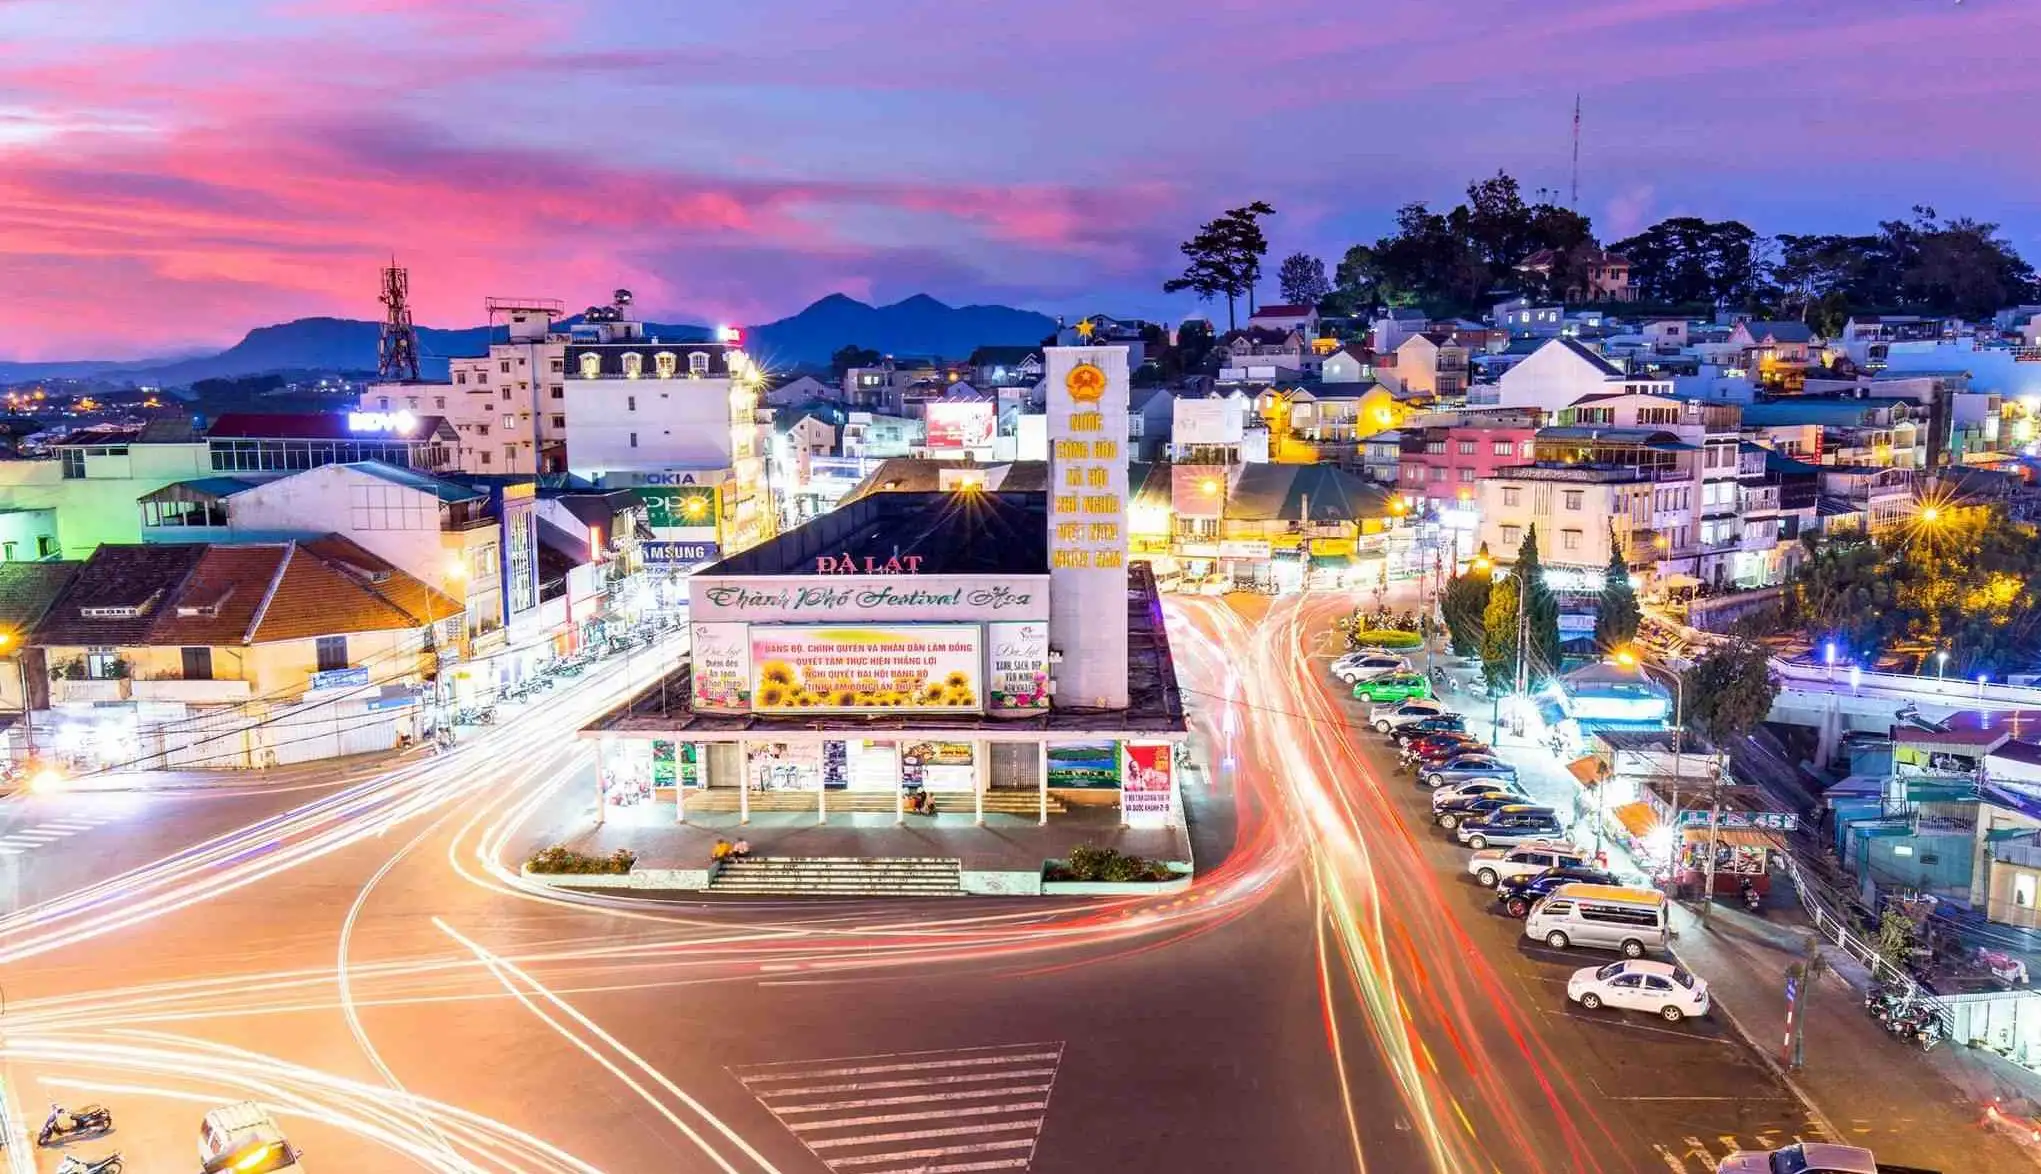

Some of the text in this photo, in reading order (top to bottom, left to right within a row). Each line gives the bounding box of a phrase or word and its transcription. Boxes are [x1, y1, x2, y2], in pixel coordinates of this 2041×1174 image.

[632, 473, 696, 484] NOKIA
[641, 546, 705, 559] MSUNG
[816, 552, 858, 571] ĐÀ
[706, 586, 1032, 610] Thành Phố Festival Hoa
